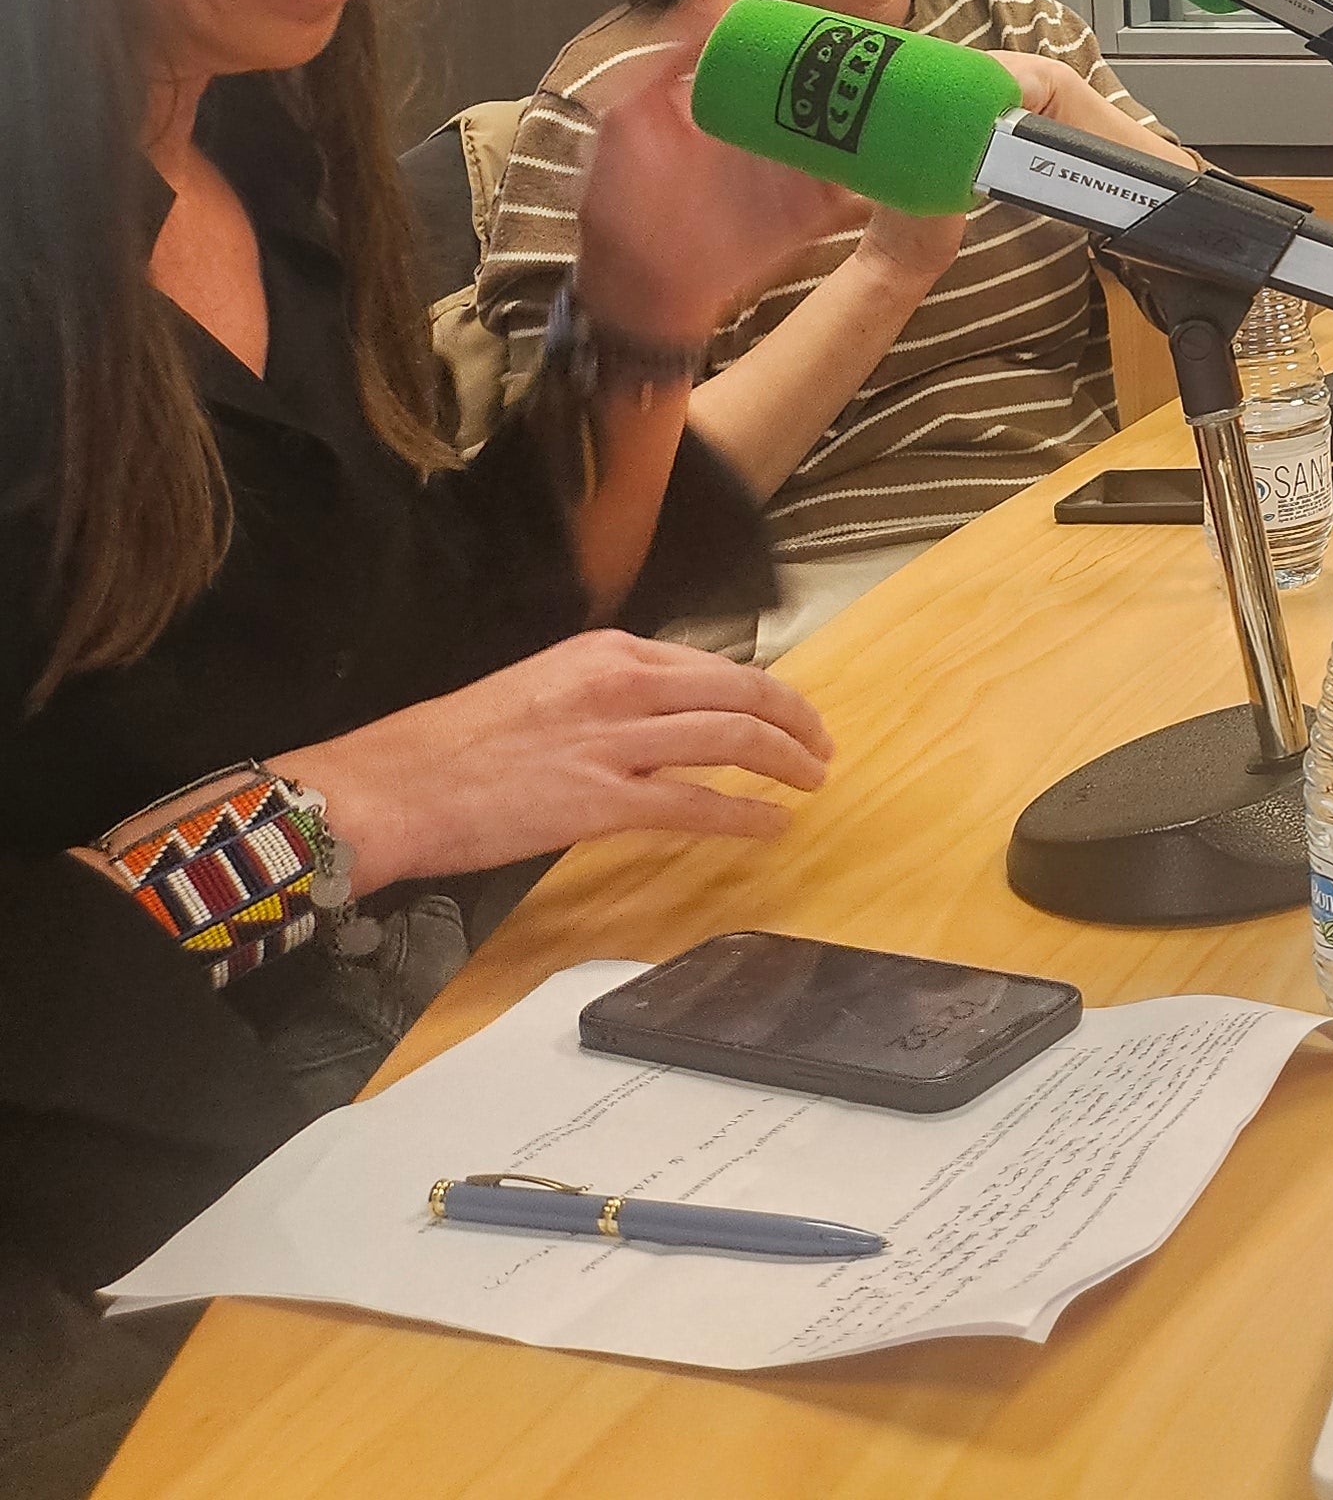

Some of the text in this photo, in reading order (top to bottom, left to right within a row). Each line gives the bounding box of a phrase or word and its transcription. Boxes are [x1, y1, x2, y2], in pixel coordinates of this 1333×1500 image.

[795, 30, 847, 116] ONDA
[829, 39, 880, 125] CERO
[1057, 167, 1160, 209] SENNHEISE
